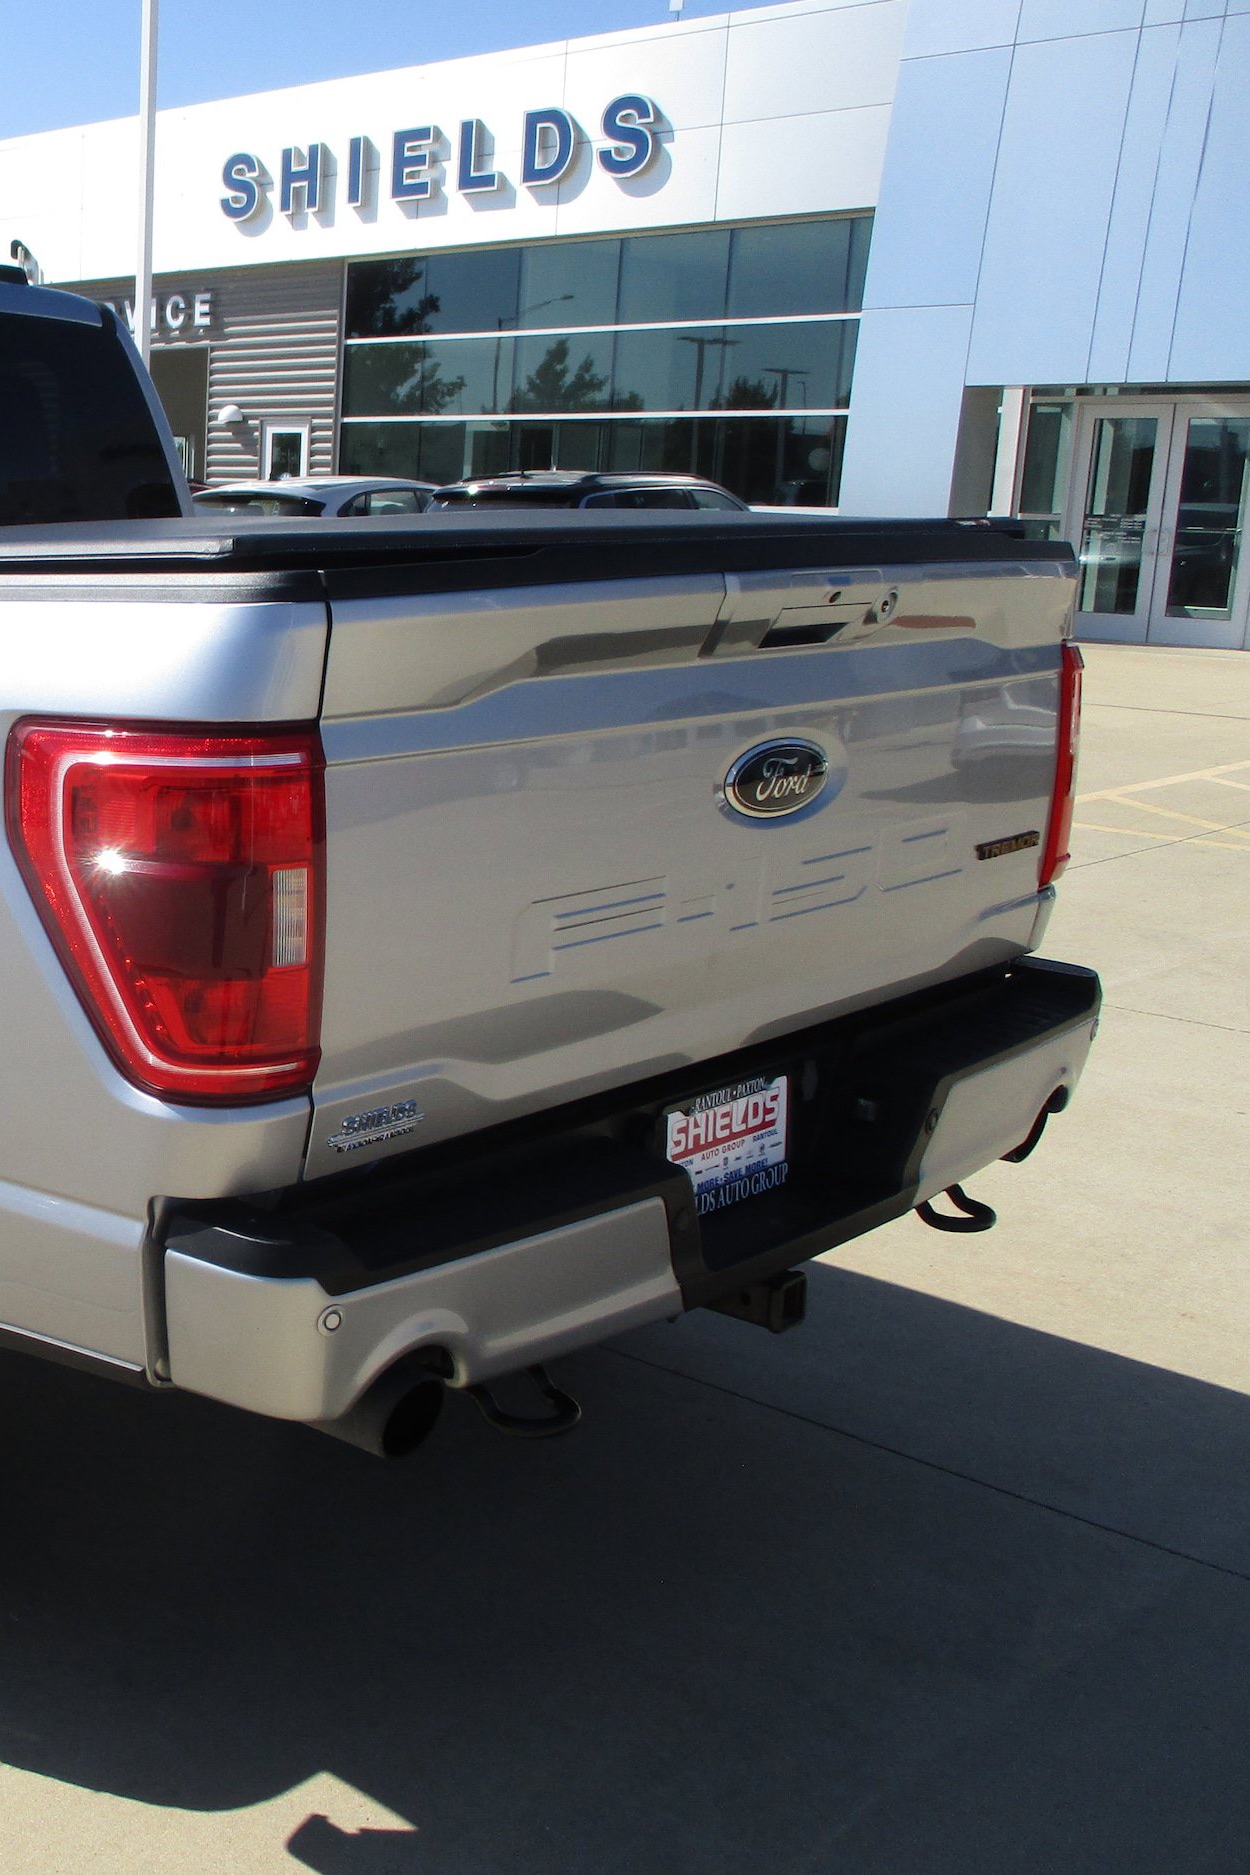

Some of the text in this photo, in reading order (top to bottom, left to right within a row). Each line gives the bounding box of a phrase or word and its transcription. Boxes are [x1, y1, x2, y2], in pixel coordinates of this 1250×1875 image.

[220, 92, 658, 224] SHIELDS
[756, 757, 812, 801] Ford
[975, 831, 1039, 860] TREMOR
[694, 1076, 766, 1112] RANTOUL PAXTON
[670, 1087, 781, 1155] SHIELDS
[701, 1149, 720, 1161] AUTO
[721, 1140, 746, 1154] GROUP
[723, 1167, 743, 1183] SAVE
[744, 1158, 768, 1175] MORE!
[717, 1178, 750, 1209] AUTO
[751, 1162, 789, 1195] GROUP
